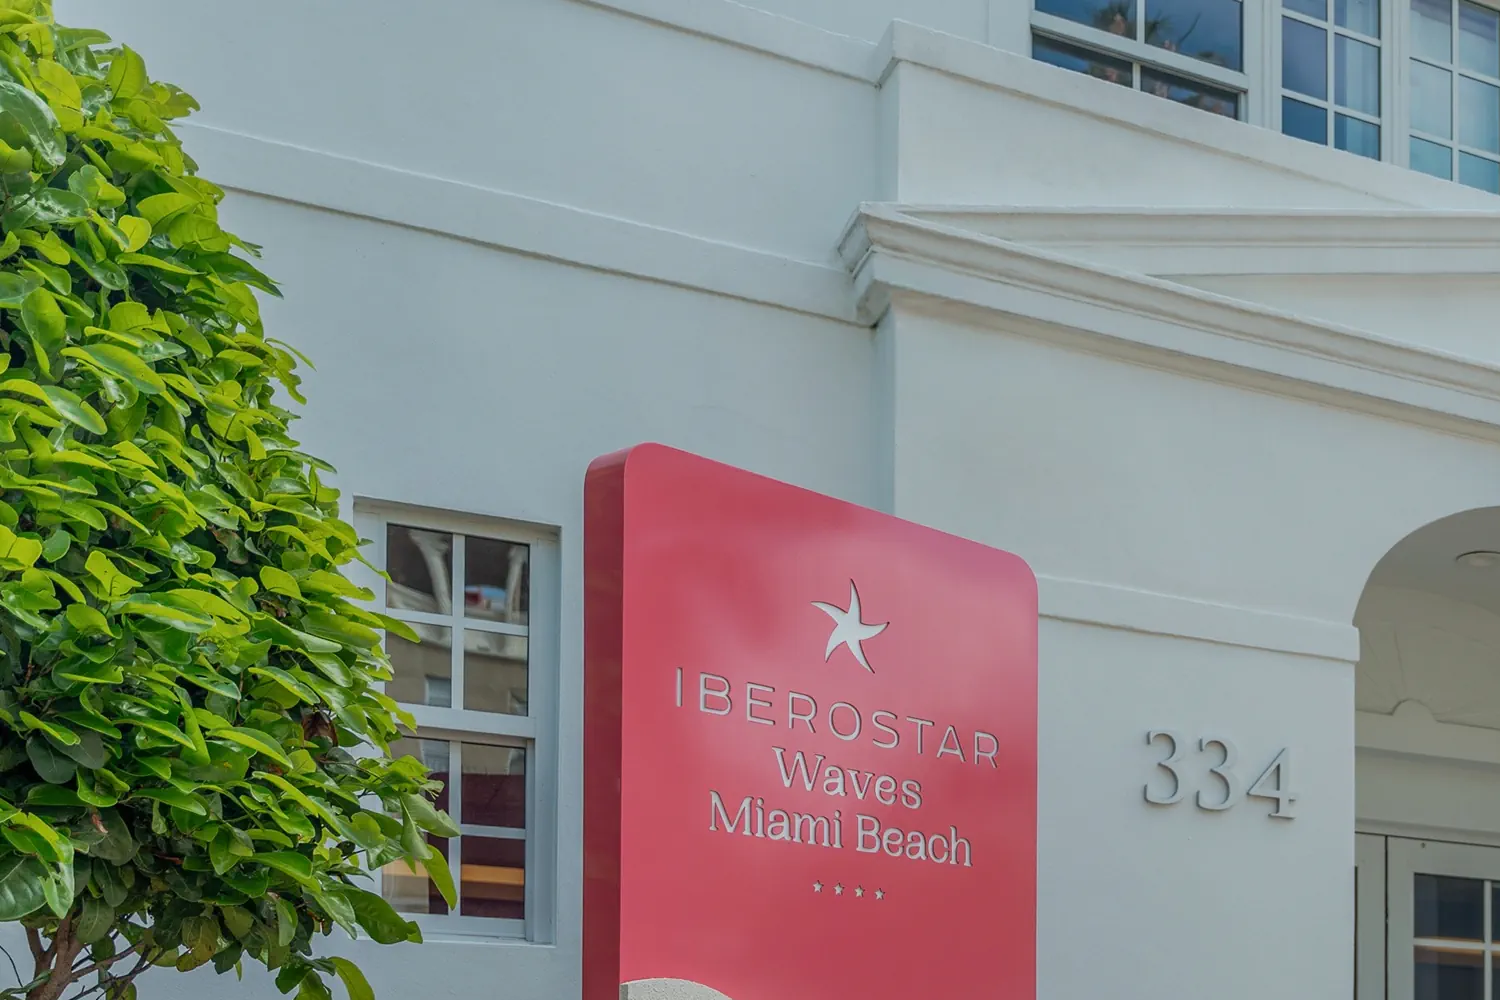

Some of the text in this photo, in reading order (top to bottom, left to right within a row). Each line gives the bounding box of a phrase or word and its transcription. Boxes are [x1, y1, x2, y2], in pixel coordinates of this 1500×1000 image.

[675, 667, 1000, 768] IBEROSTAR
[771, 746, 923, 809] Waves
[1143, 730, 1298, 820] 334
[709, 790, 972, 867] Miami Beach
